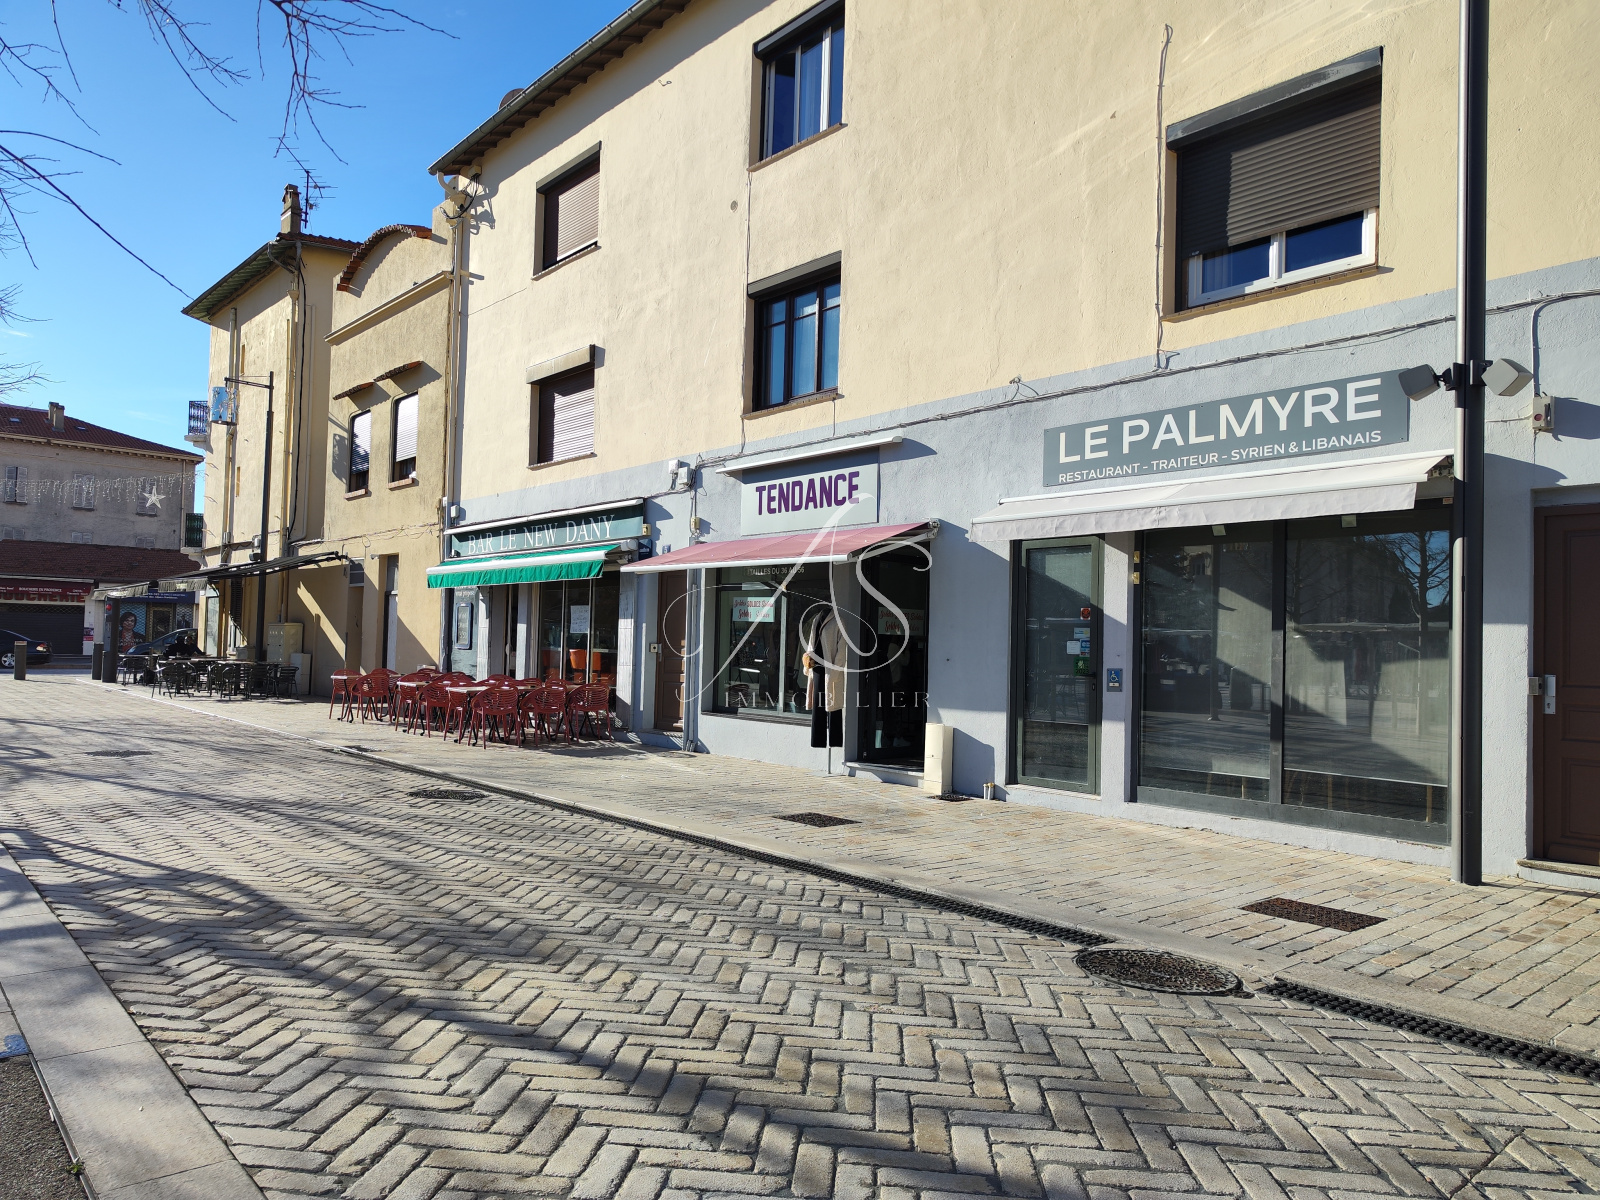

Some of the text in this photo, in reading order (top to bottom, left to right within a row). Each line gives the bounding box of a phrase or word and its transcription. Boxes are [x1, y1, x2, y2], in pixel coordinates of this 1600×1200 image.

[1059, 377, 1382, 464] LE PALMYRE
[1058, 463, 1141, 483] RESTAURANT
[1150, 452, 1219, 471] TRAITEUR
[1230, 443, 1285, 461] SYRIEN
[1288, 441, 1299, 453] &
[1302, 430, 1382, 452] LIBANAIS
[755, 470, 860, 516] TENDANCE
[467, 514, 615, 555] BAR LE NEW DANY
[772, 567, 780, 575] DU
[0, 592, 86, 603] OUCHERIE
